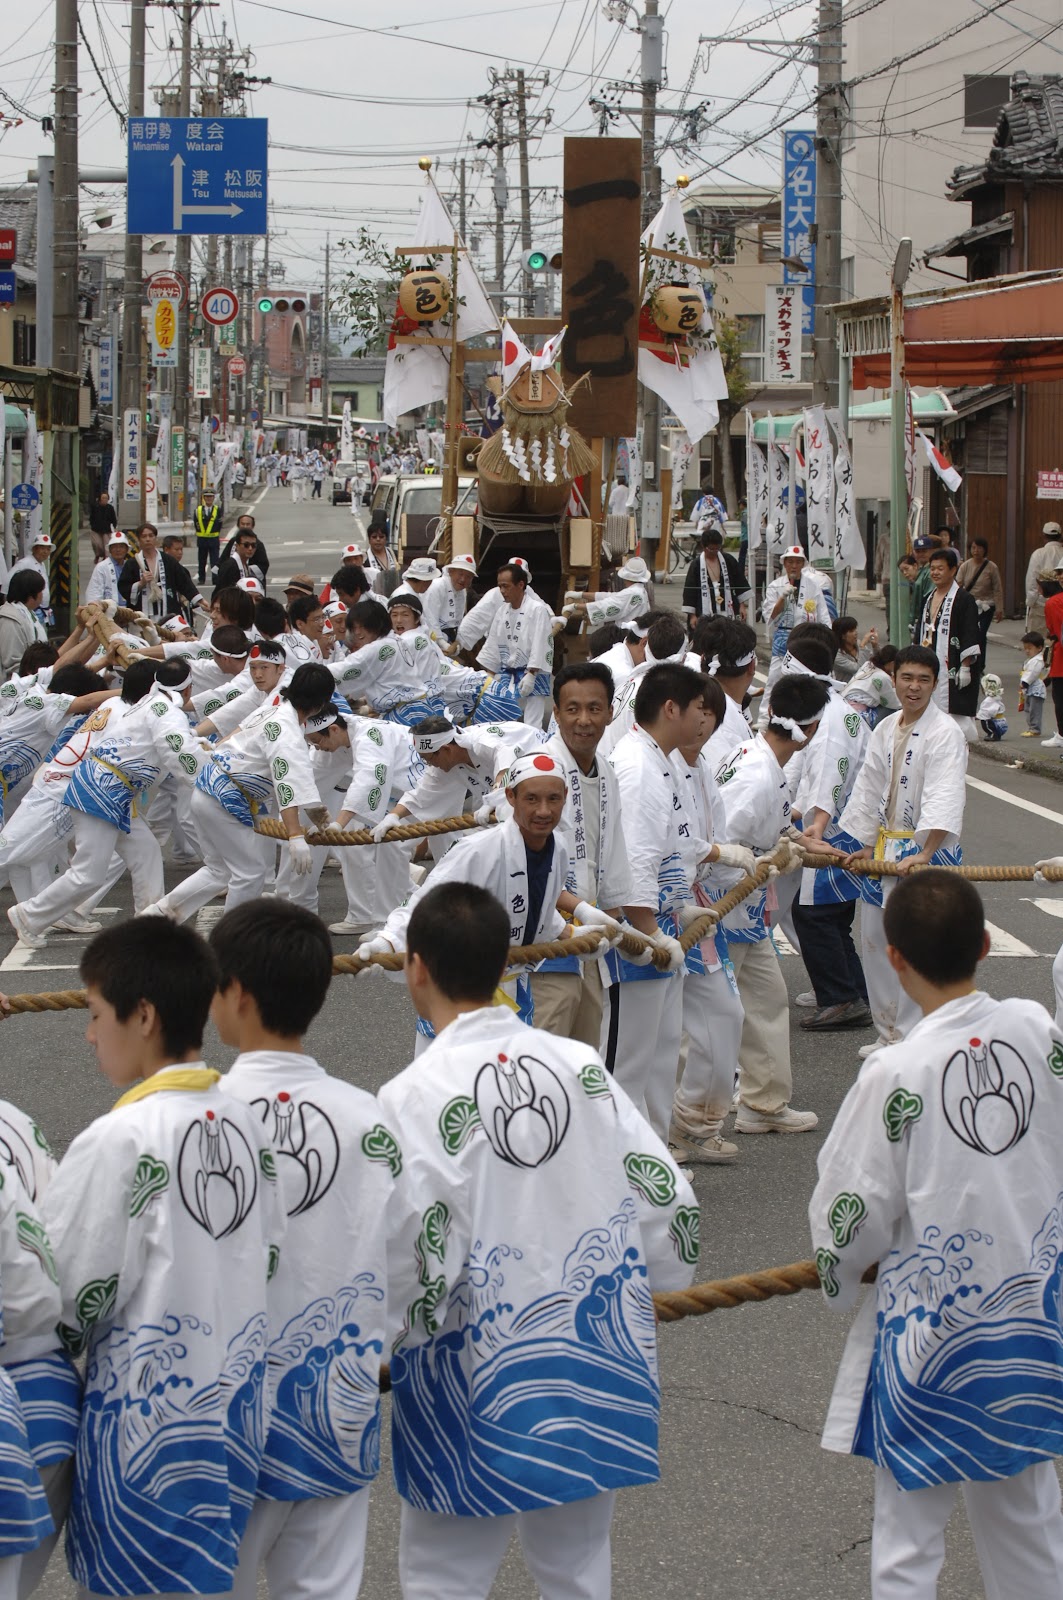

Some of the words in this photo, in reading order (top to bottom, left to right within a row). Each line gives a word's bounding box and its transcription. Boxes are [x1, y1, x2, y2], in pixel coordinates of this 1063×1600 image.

[131, 122, 172, 140] 南伊勢
[186, 122, 224, 140] 度会
[133, 142, 169, 151] Minamiise
[186, 142, 223, 151] Watarai
[191, 169, 209, 186] 津
[224, 169, 262, 187] 松阪
[192, 188, 209, 198] Tsu
[224, 189, 262, 198] Matsusaka
[411, 276, 441, 314] 一色
[776, 287, 795, 295] 専門
[210, 298, 230, 315] 40
[677, 294, 699, 331] 一色
[160, 307, 172, 345] カクテル
[776, 296, 792, 372] メガネのワキタ
[419, 739, 434, 750] 祝
[568, 768, 587, 861] 一色町奉献団
[510, 870, 527, 941] 一色町
